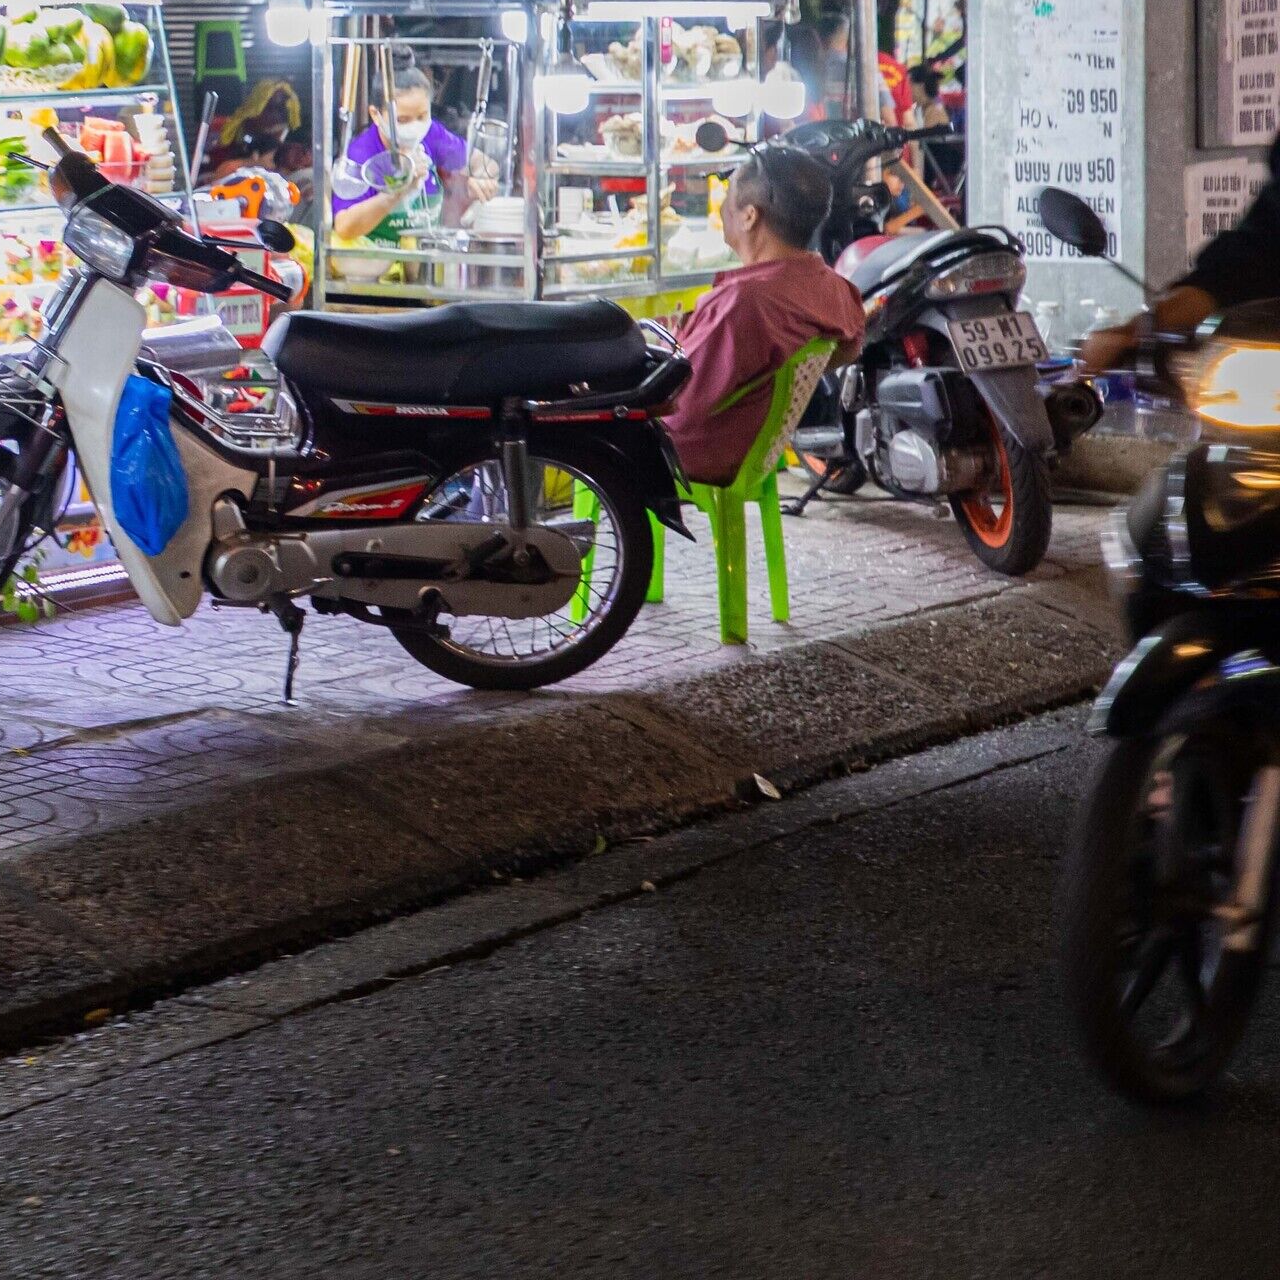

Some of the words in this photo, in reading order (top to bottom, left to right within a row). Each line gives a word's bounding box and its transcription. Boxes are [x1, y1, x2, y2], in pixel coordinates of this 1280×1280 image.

[1090, 87, 1118, 114] 950
[1087, 157, 1115, 183] 950
[963, 337, 1042, 368] 099.25
[395, 405, 450, 417] HONDA
